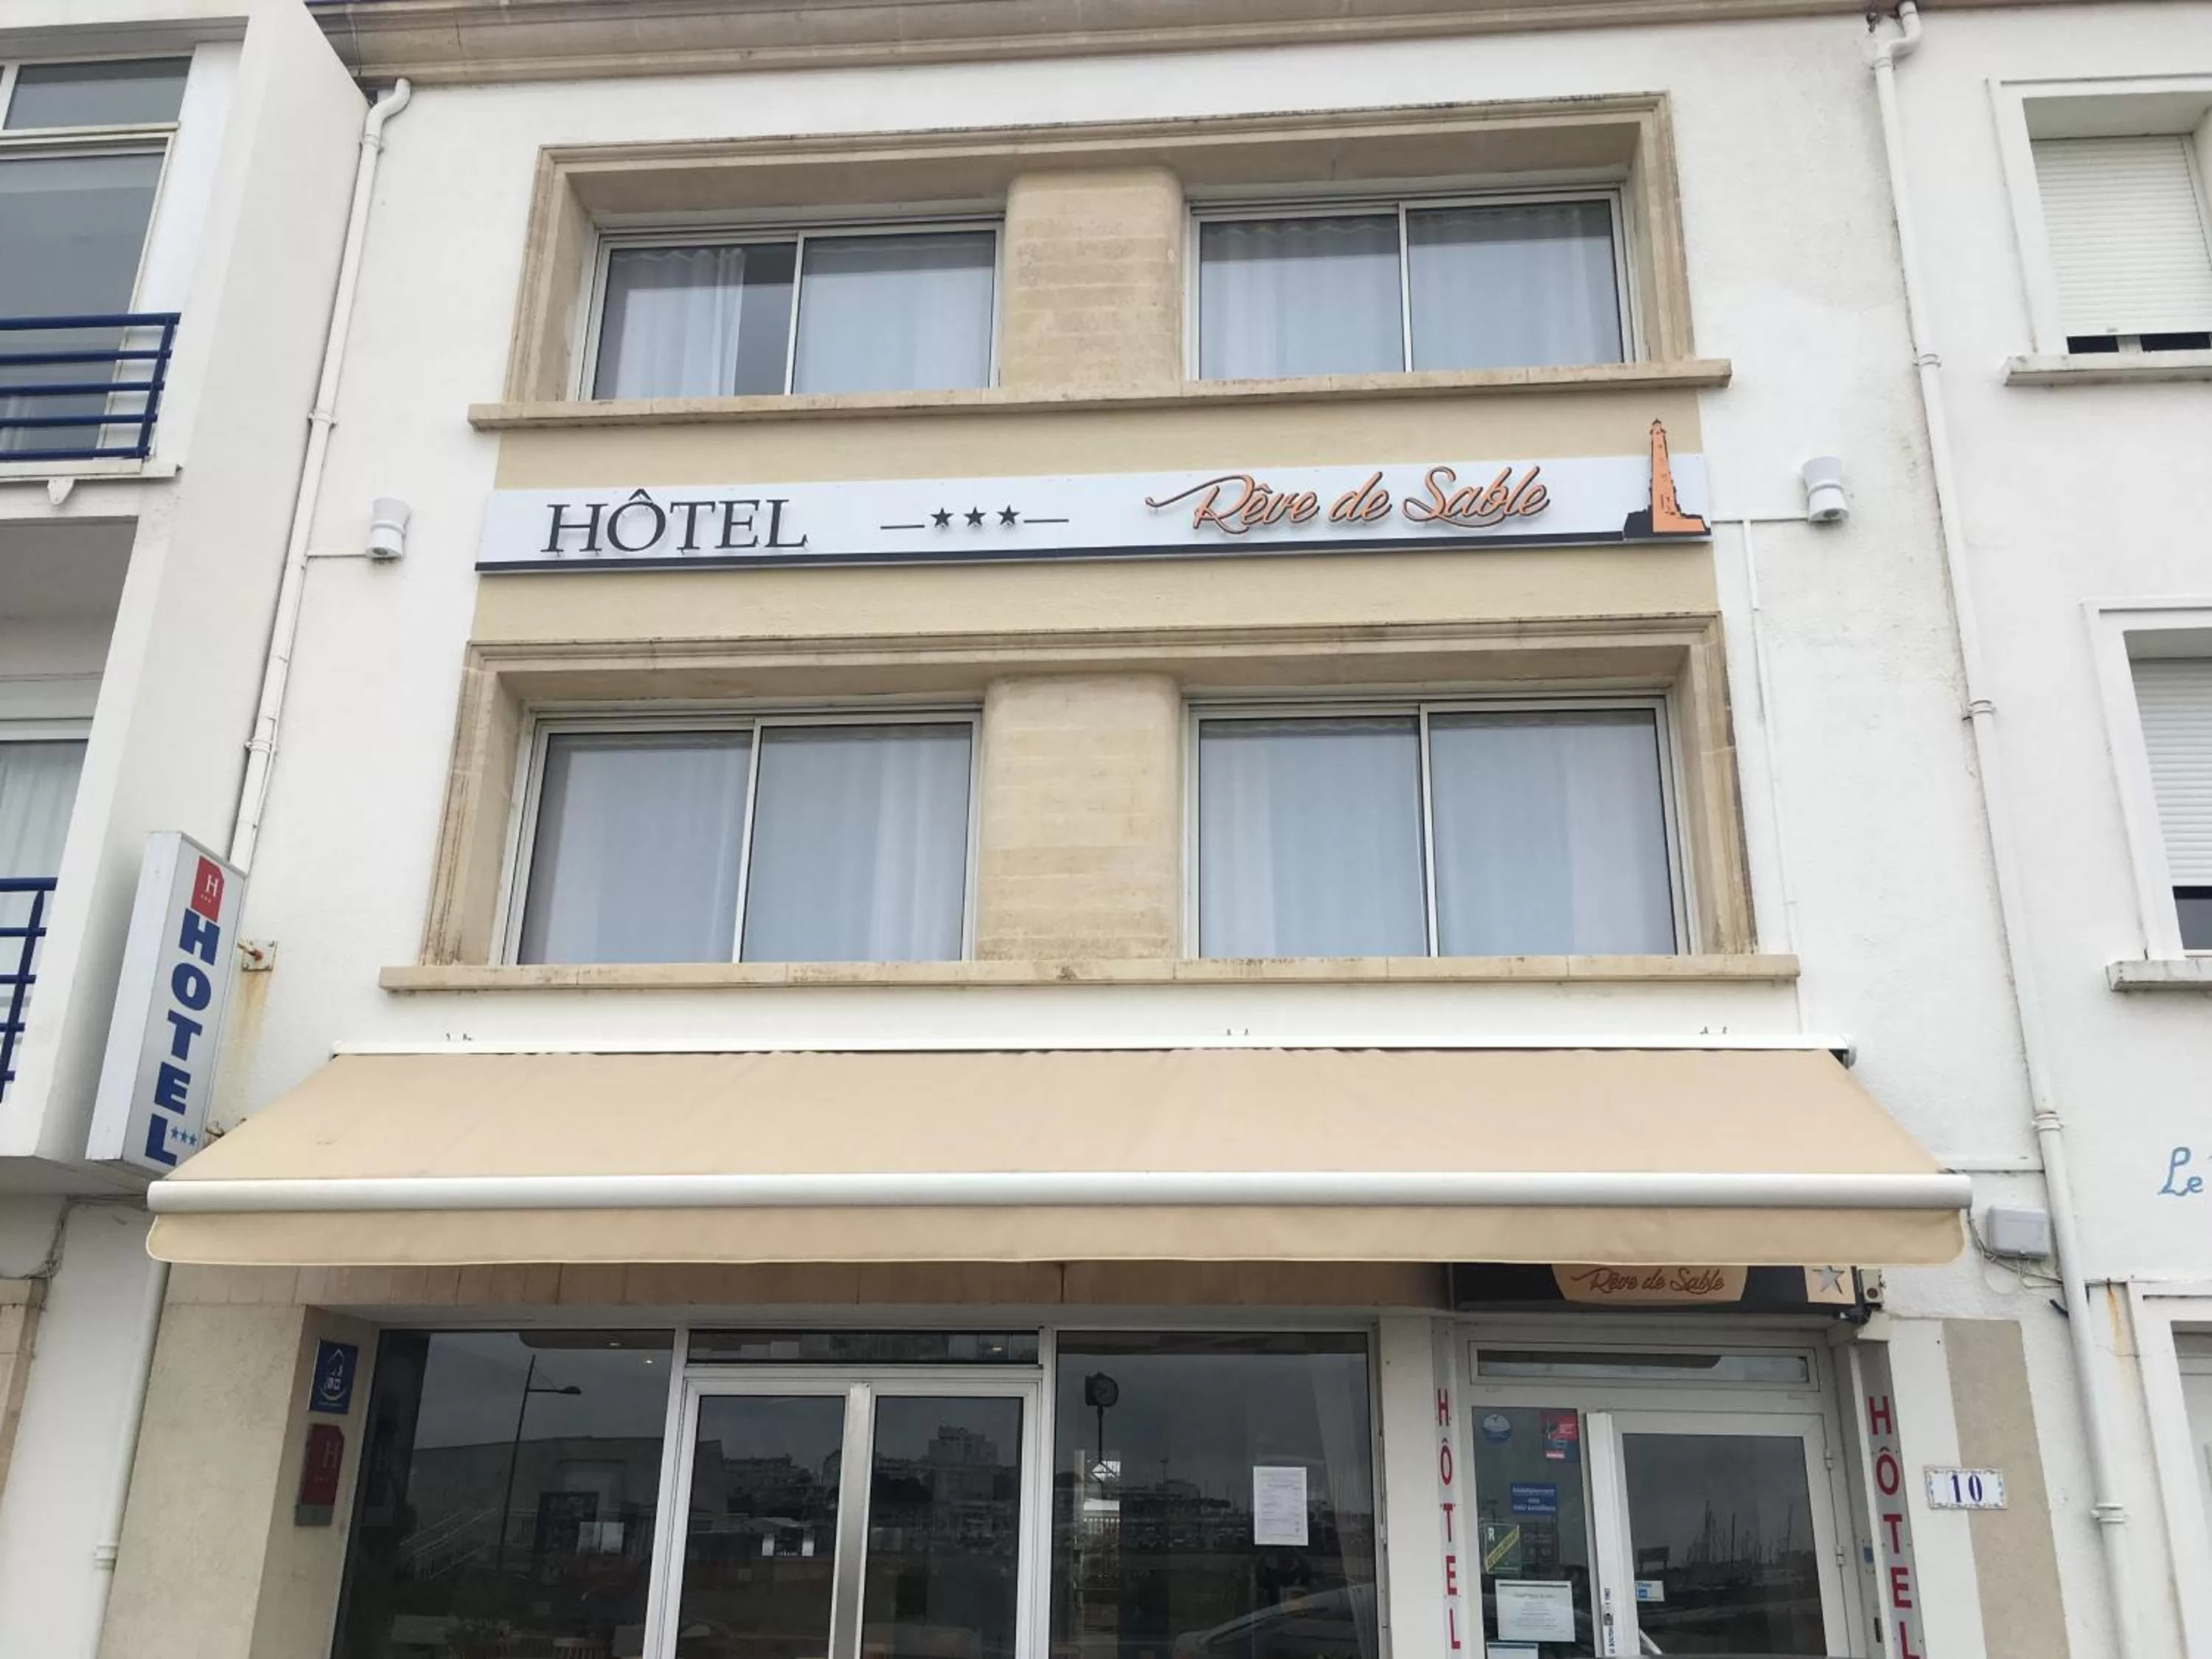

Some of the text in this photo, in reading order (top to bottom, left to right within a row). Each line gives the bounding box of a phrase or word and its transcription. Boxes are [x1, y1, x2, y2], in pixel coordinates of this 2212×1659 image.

[540, 488, 808, 553] HÔTEL
[1144, 465, 1551, 534] Rêve de Sable
[205, 872, 218, 899] H
[145, 908, 220, 1167] HOTEL
[2155, 1147, 2205, 1197] Le
[1571, 1267, 1725, 1295] Rêve de Sable
[1438, 1389, 1461, 1649] HÔTEL
[1951, 1475, 1983, 1503] 10
[1868, 1396, 1921, 1659] HÔTEL
